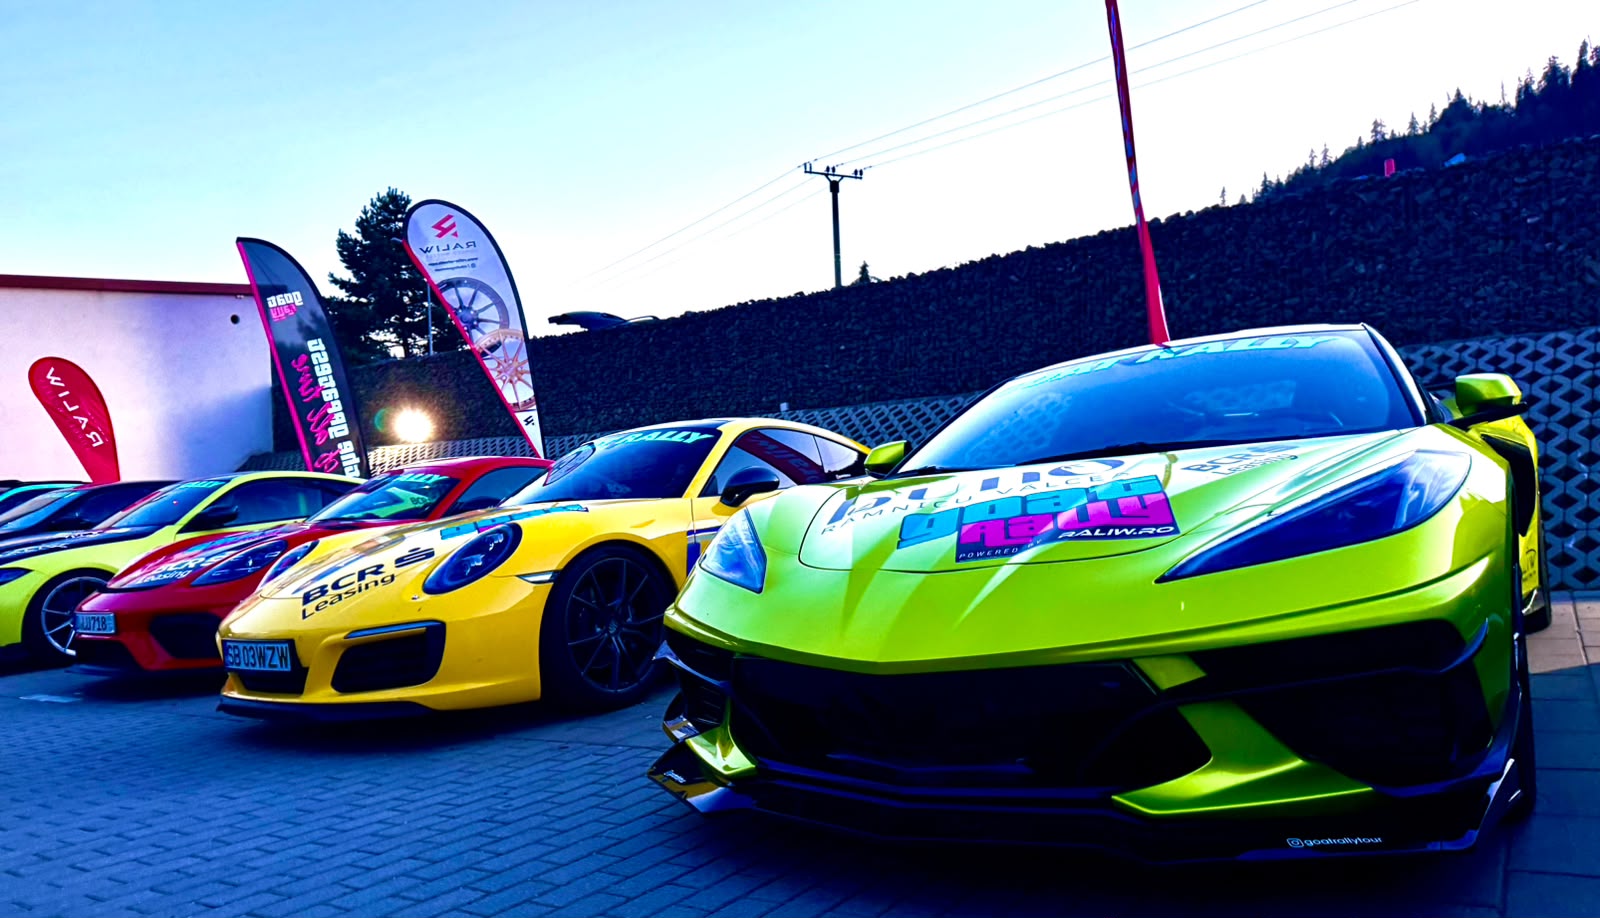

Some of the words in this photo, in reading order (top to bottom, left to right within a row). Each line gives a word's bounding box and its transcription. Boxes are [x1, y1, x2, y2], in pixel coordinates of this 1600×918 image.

[614, 430, 714, 445] RALLY
[821, 495, 972, 536] RAMNICU
[1057, 525, 1176, 540] RALIW.RO
[957, 546, 1020, 560] POWERED
[302, 563, 385, 607] BCR
[302, 573, 396, 621] Leasing
[1304, 836, 1382, 847] goatrallytour
